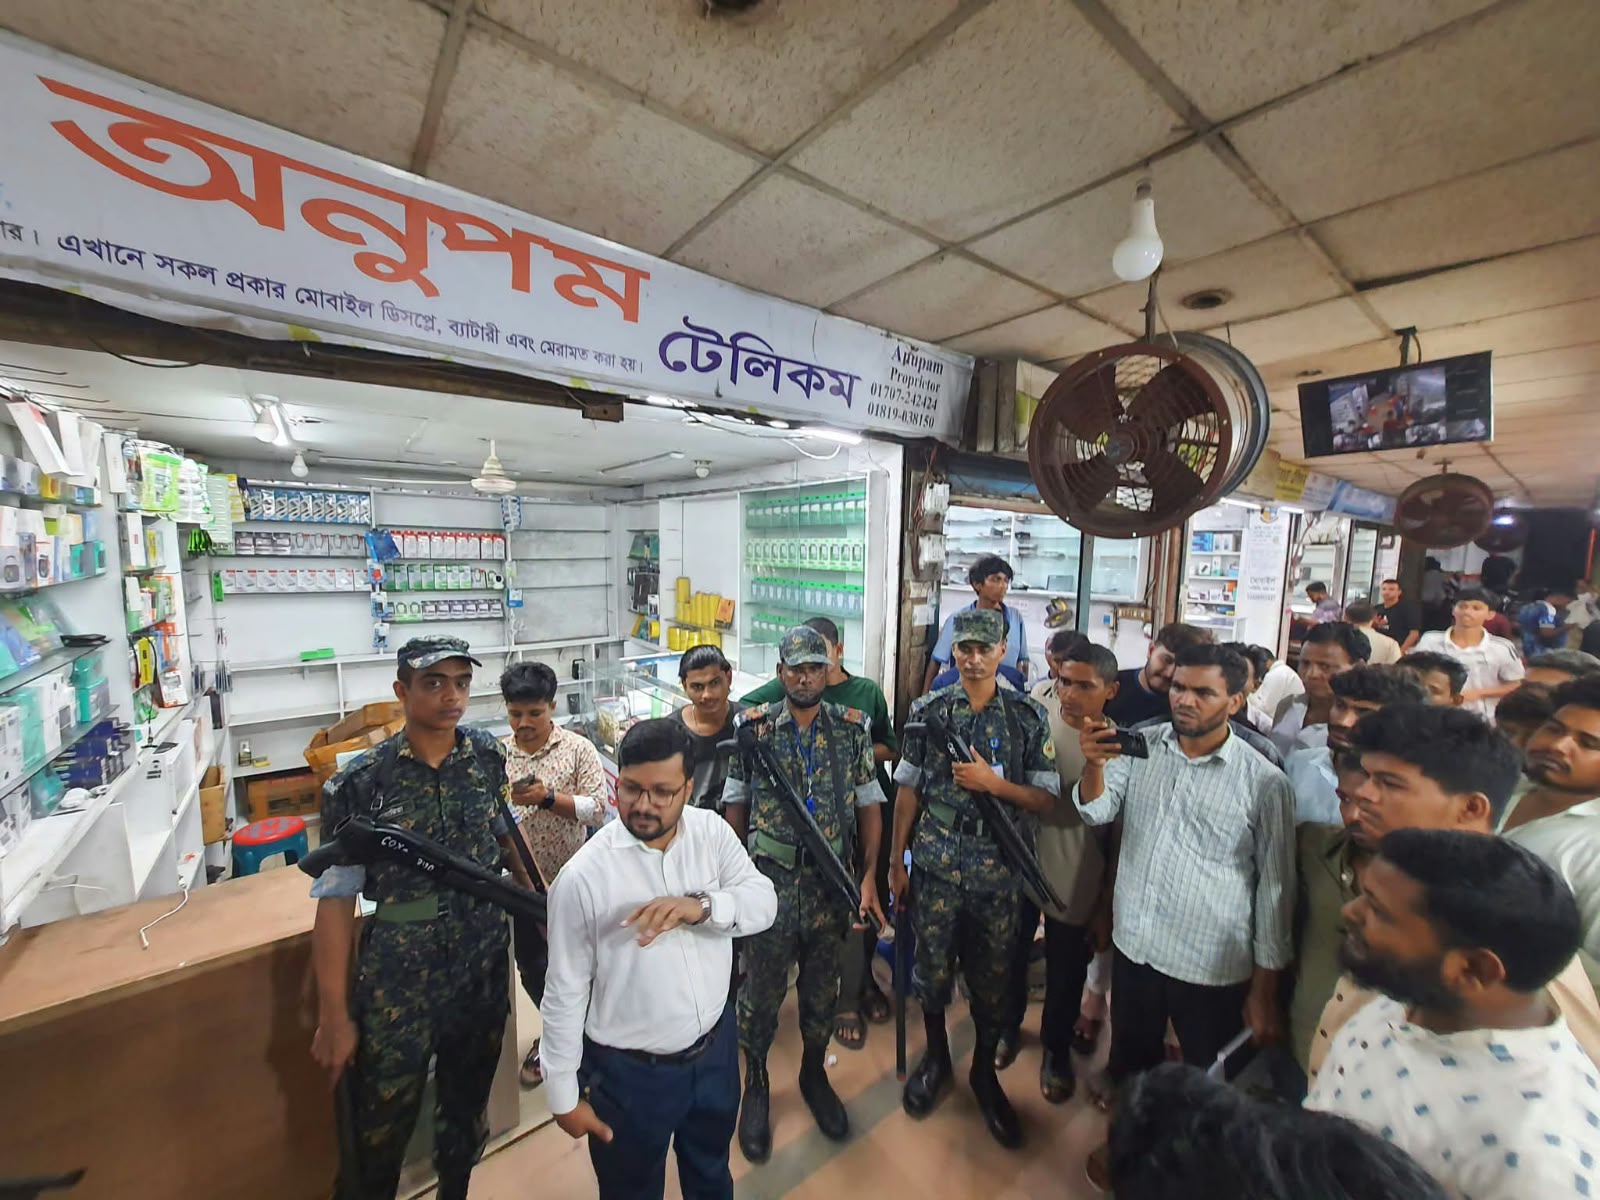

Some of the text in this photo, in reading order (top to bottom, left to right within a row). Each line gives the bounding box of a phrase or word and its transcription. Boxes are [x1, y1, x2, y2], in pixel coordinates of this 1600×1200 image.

[38, 76, 651, 324] অনুপম
[58, 235, 146, 270] এখানে
[153, 253, 218, 286] সকল
[226, 271, 286, 300] প্রকার
[296, 286, 373, 320] মোবাইল
[448, 318, 500, 345] ব্যাটারী
[506, 333, 534, 354] এবং
[540, 340, 589, 361] মেরামত
[594, 351, 616, 369] করা
[659, 316, 863, 408] টেলিকম
[890, 367, 941, 393] Proprietor
